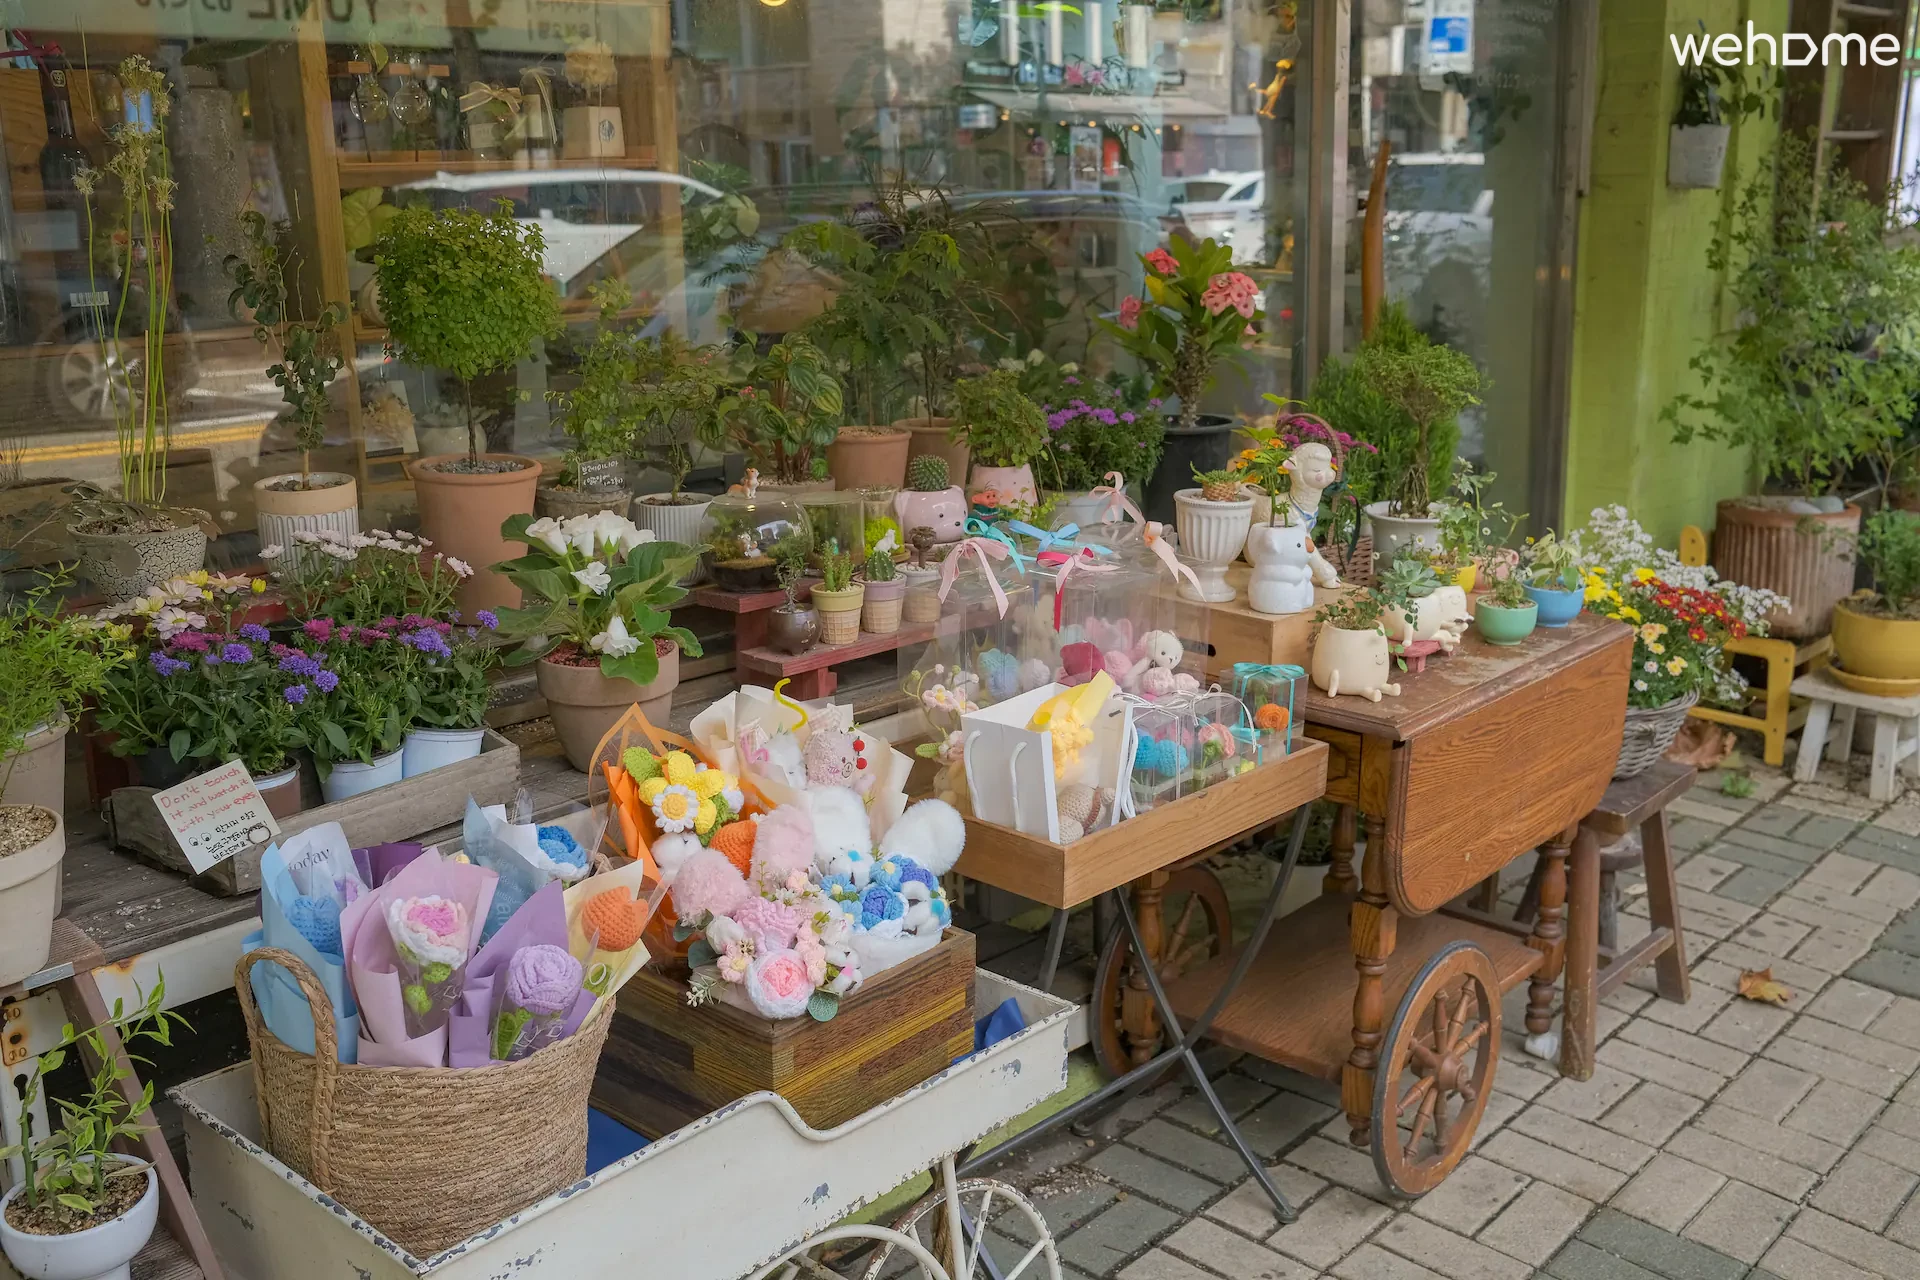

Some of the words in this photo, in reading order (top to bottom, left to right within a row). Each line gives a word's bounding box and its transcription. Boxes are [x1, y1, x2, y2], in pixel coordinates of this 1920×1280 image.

[160, 786, 200, 808] Don't
[204, 768, 241, 787] touch
[169, 810, 183, 820] it
[189, 797, 207, 811] and
[208, 784, 239, 801] watch
[177, 815, 204, 833] with
[207, 803, 232, 819] your
